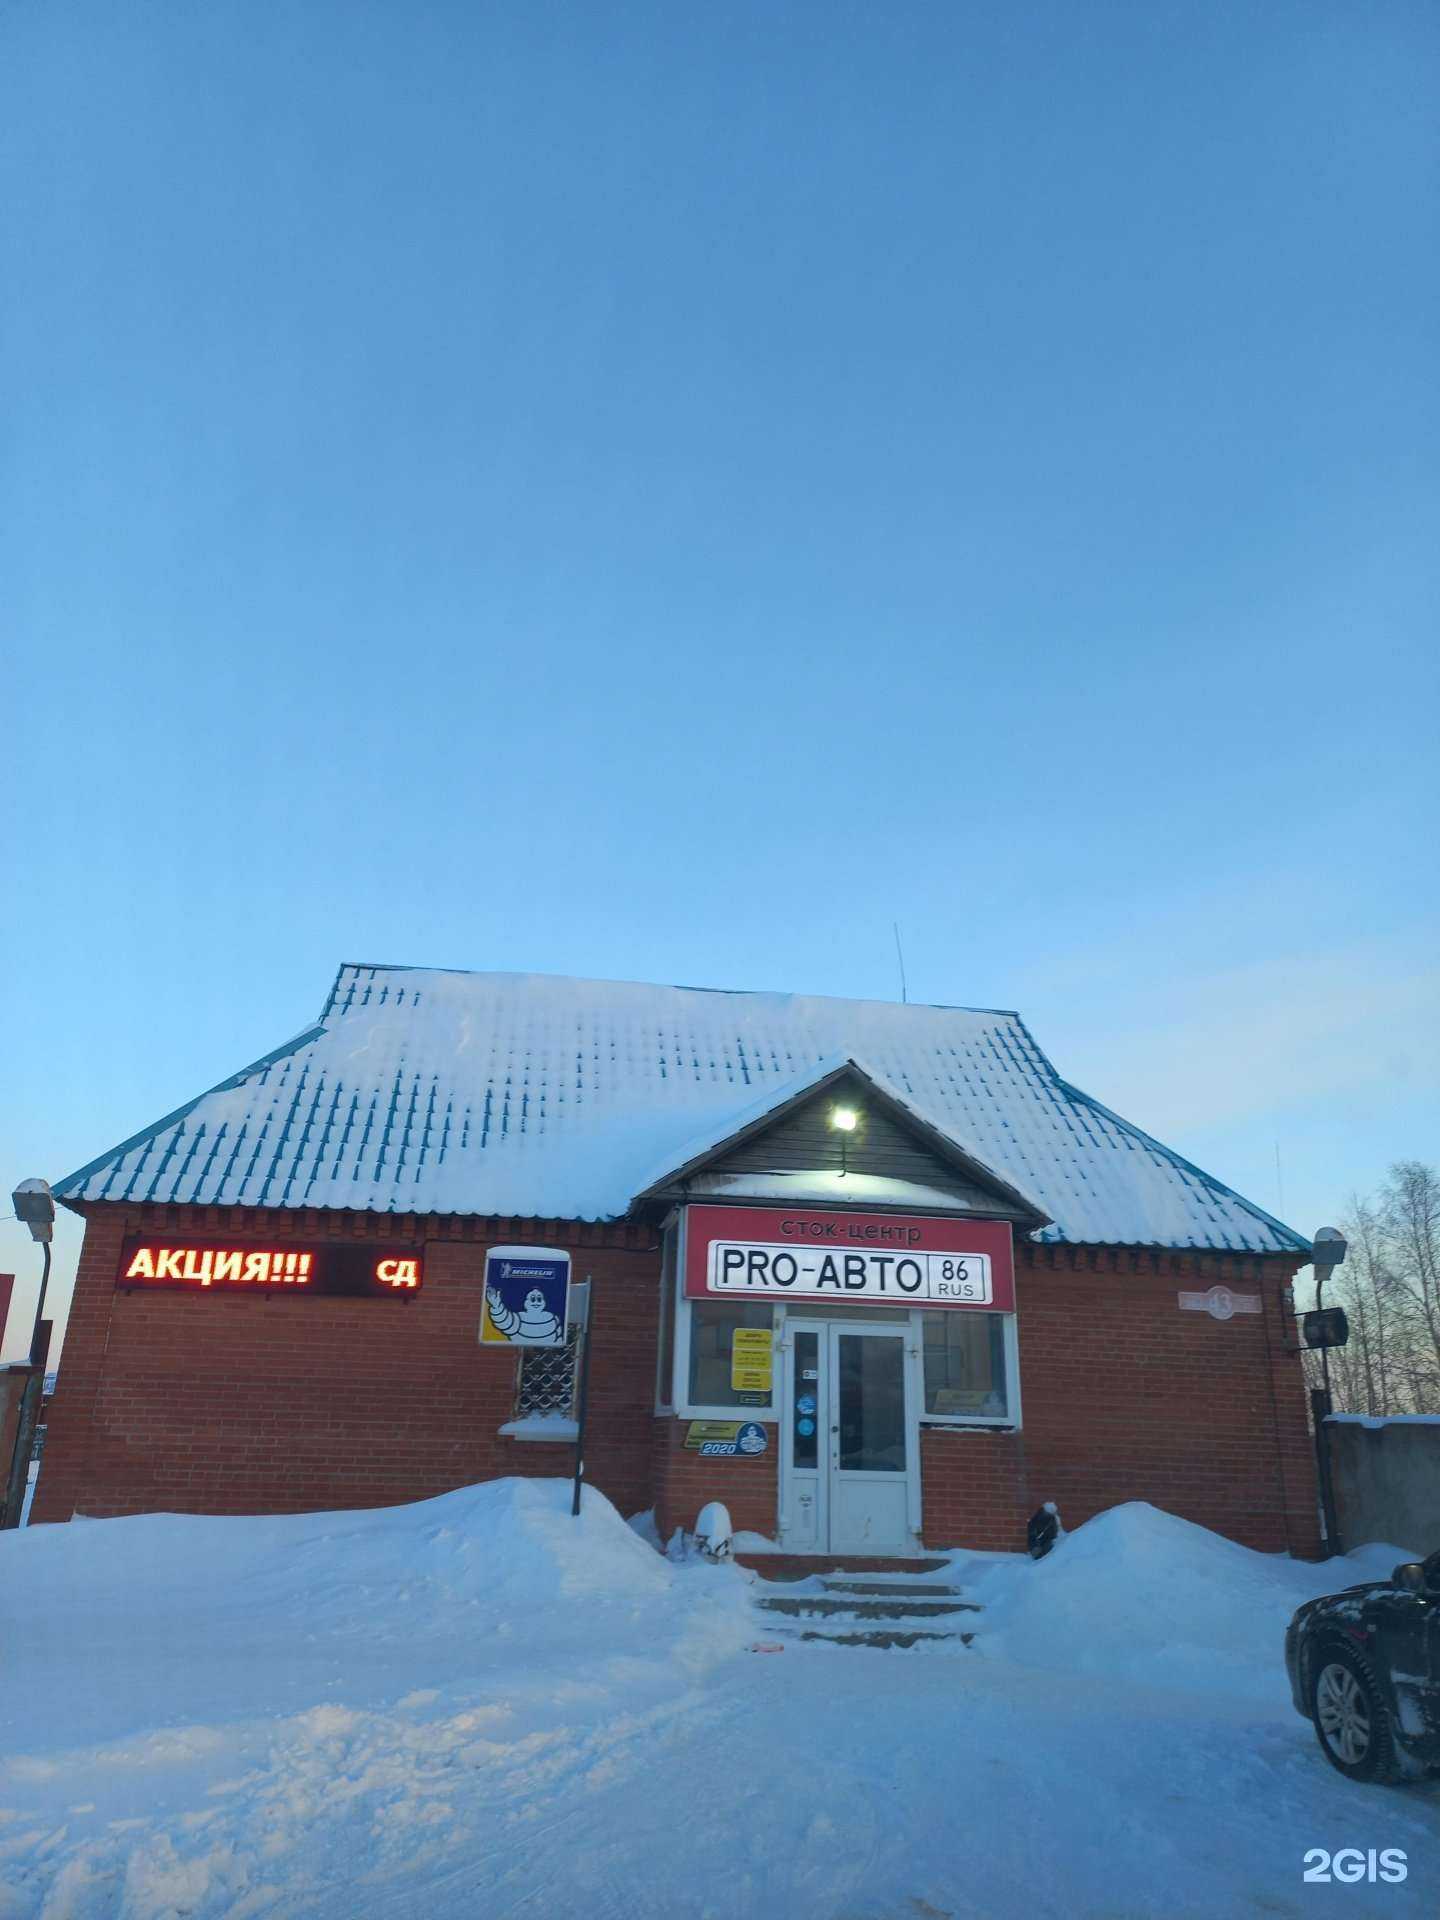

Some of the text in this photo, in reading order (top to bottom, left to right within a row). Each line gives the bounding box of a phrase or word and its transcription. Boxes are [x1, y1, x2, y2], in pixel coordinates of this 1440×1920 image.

[126, 1249, 311, 1285] АКЦИЯ!!!
[722, 1249, 922, 1292] PRO-АВТО
[942, 1260, 968, 1281] 86
[938, 1283, 973, 1296] RUS
[1209, 1293, 1232, 1313] 43
[703, 1444, 736, 1454] 2020
